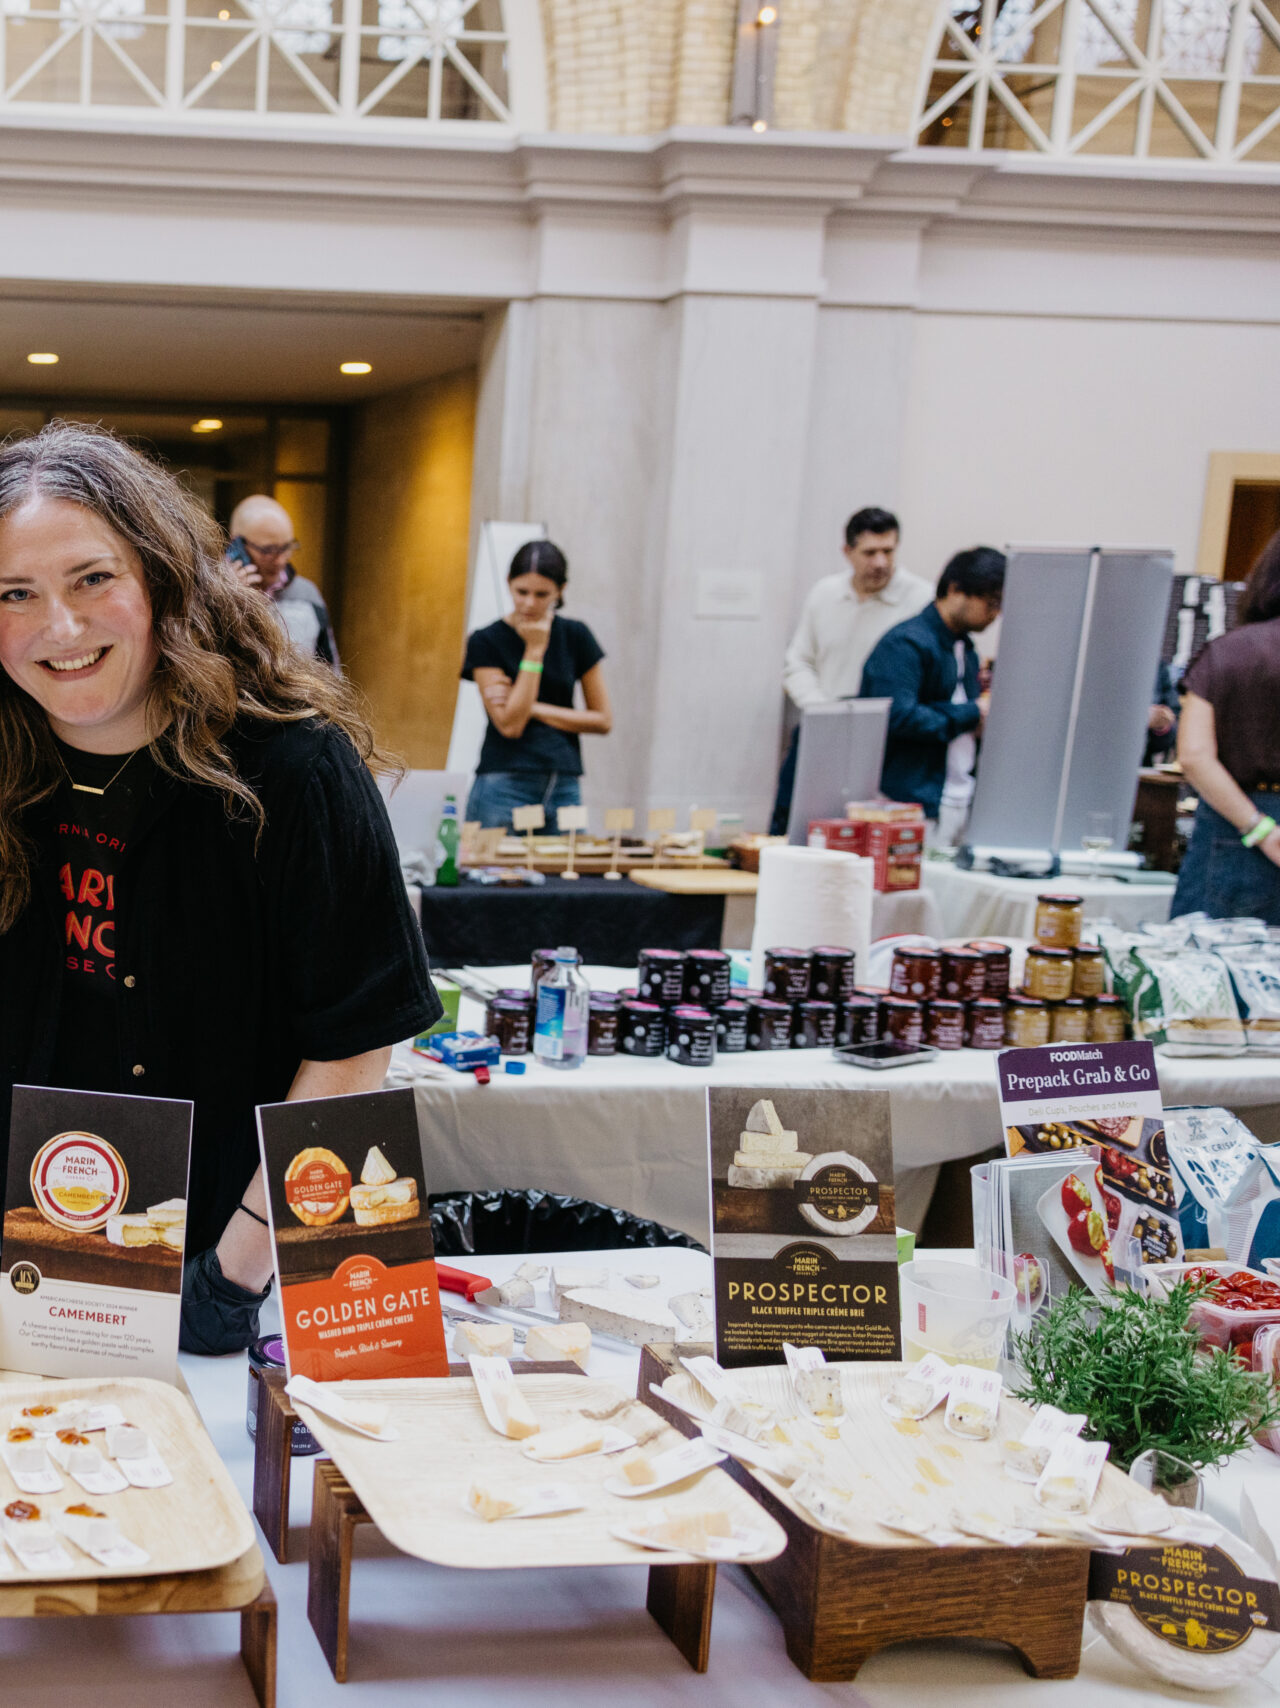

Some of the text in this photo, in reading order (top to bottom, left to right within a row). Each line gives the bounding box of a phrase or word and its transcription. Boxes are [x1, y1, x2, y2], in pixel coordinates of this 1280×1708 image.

[1049, 1049, 1103, 1063] FOODMatch
[1007, 1064, 1150, 1093] Prepack Grab & Go
[1028, 1107, 1043, 1116] Deli
[1102, 1101, 1116, 1110] and
[1117, 1100, 1138, 1109] More
[65, 1156, 96, 1165] MARIN
[62, 1165, 98, 1176] FRENCH
[293, 1183, 324, 1195] GOLDEN
[324, 1179, 343, 1190] GATE
[810, 1187, 868, 1196] PROSPECTOR
[58, 1191, 99, 1201] CAMEMBERT
[794, 1256, 818, 1265] MARIN
[349, 1269, 370, 1280] MARIN
[792, 1264, 820, 1273] FRENCH
[348, 1277, 373, 1289] FRENCH
[728, 1281, 888, 1305] PROSPECTOR
[48, 1305, 127, 1326] CAMEMBERT
[296, 1287, 431, 1329] GOLDEN GATE
[751, 1306, 773, 1315] BLACK
[774, 1306, 801, 1316] TRUFFLE
[803, 1307, 825, 1317] TRIPLE
[850, 1308, 865, 1317] BRIE
[318, 1327, 341, 1340] WASHED
[357, 1321, 375, 1333] TRIPLE
[394, 1313, 414, 1326] CHEESE
[1163, 1546, 1202, 1561] MARIN
[1161, 1555, 1208, 1574] FRENCH
[1117, 1568, 1259, 1609] PROSPECTOR
[1139, 1590, 1158, 1601] BLACK
[1159, 1593, 1183, 1605] TRUFFLE
[1184, 1597, 1204, 1609] TRIPLE
[1225, 1605, 1240, 1616] BRIE
